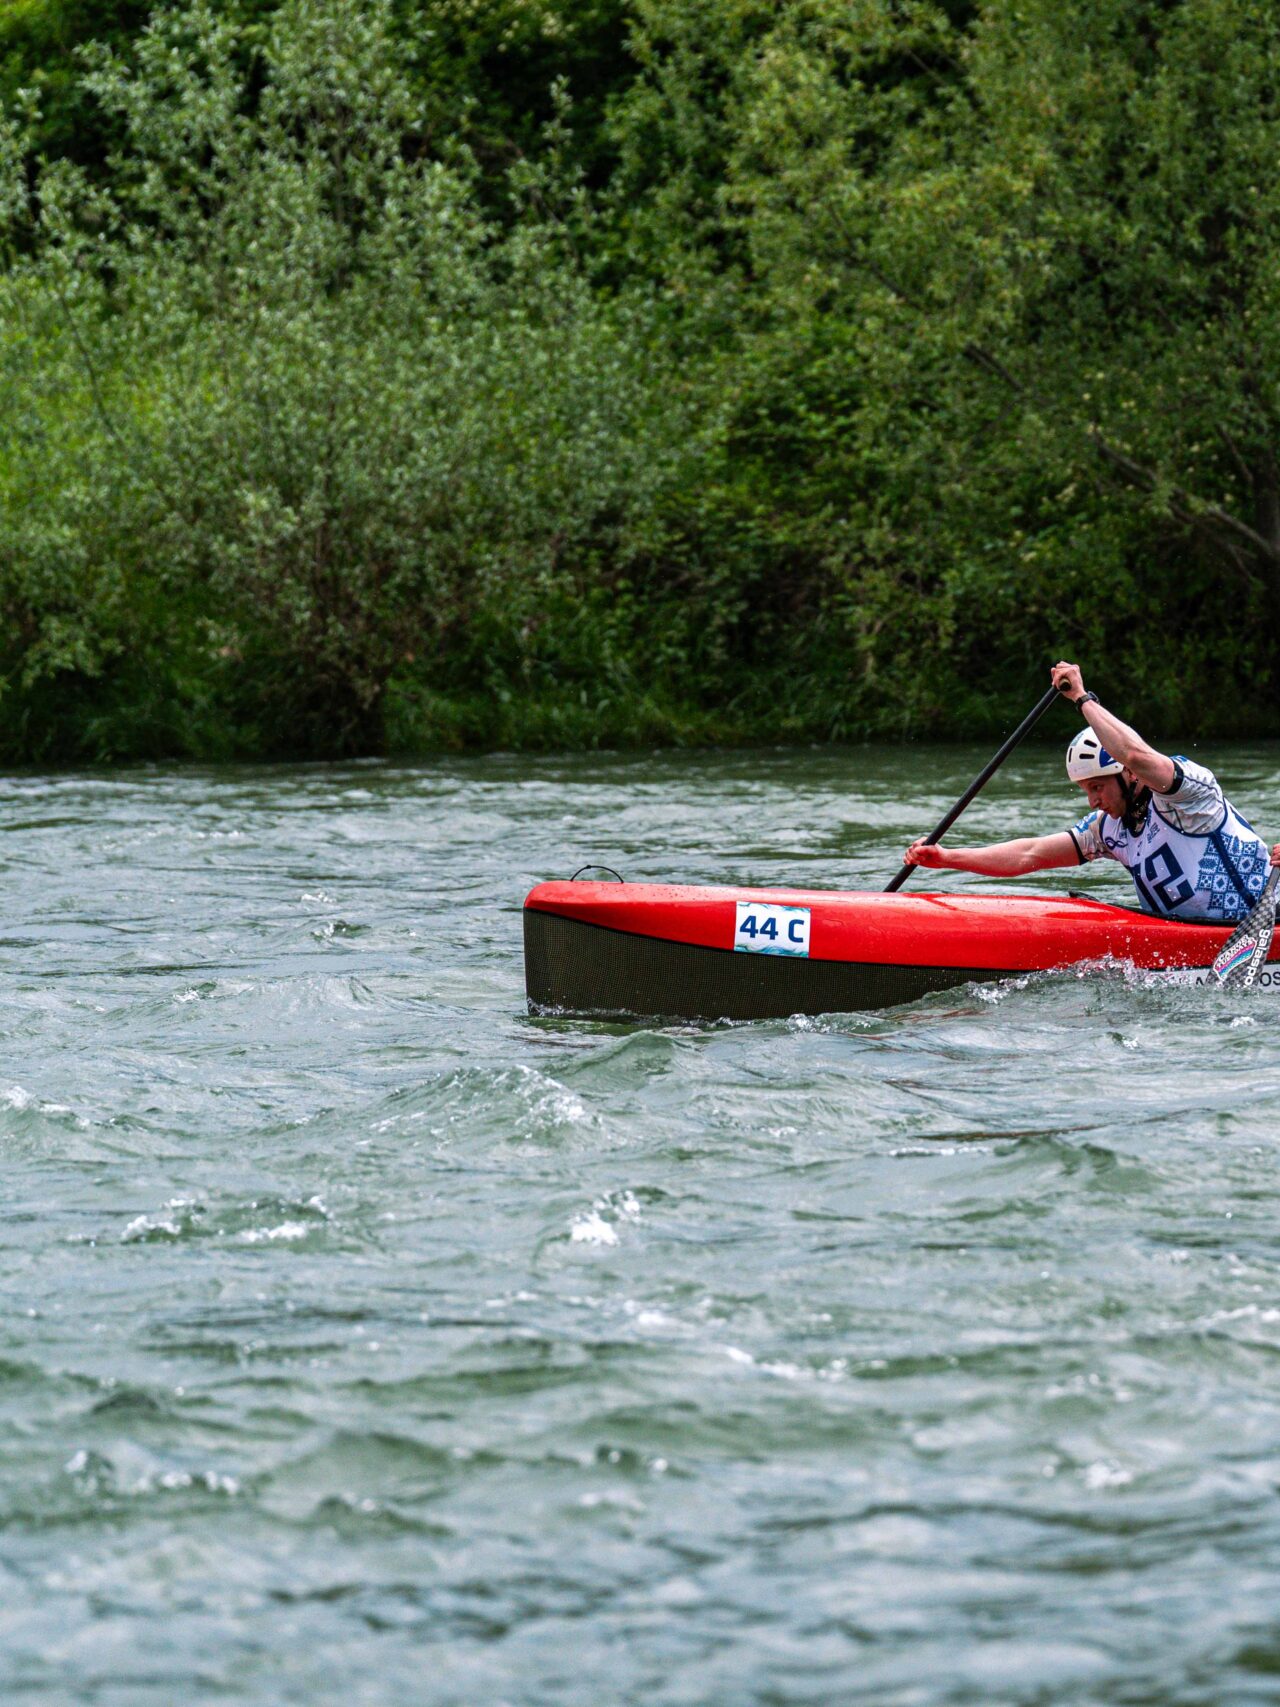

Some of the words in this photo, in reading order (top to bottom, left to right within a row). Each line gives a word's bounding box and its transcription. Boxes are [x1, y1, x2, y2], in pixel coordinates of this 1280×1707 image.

[739, 915, 779, 941] 44
[788, 918, 805, 943] C
[1243, 928, 1271, 989] galaspo
